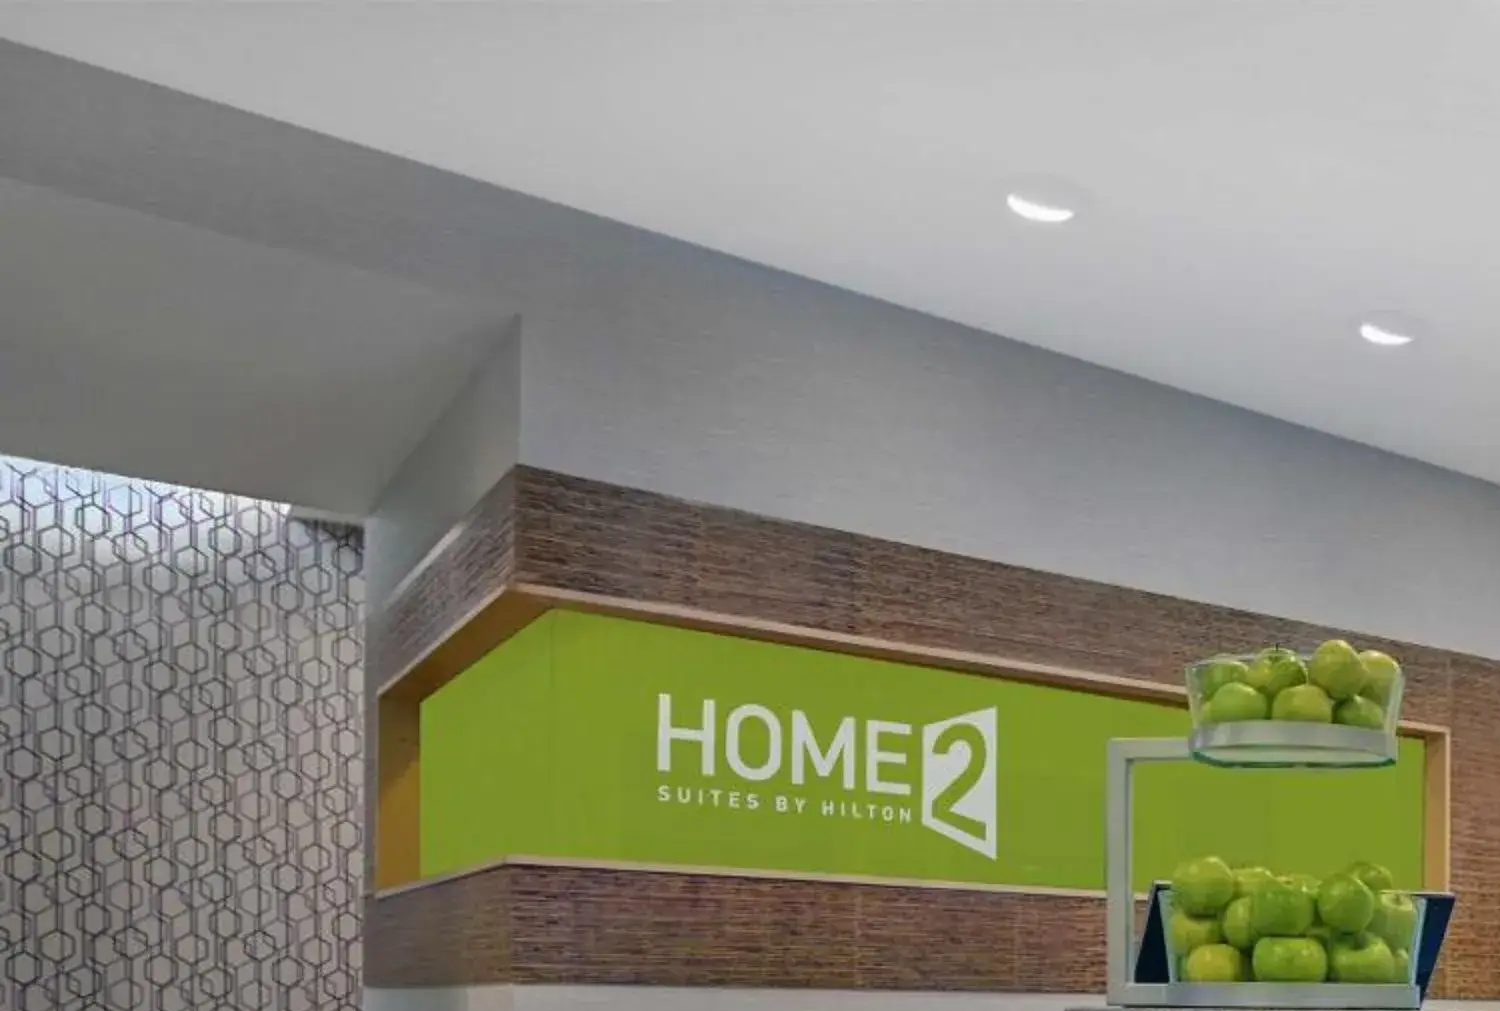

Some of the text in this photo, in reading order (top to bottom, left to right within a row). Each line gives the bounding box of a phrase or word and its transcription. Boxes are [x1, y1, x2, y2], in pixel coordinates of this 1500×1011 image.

[656, 784, 913, 825] SUITES BY HILTON
